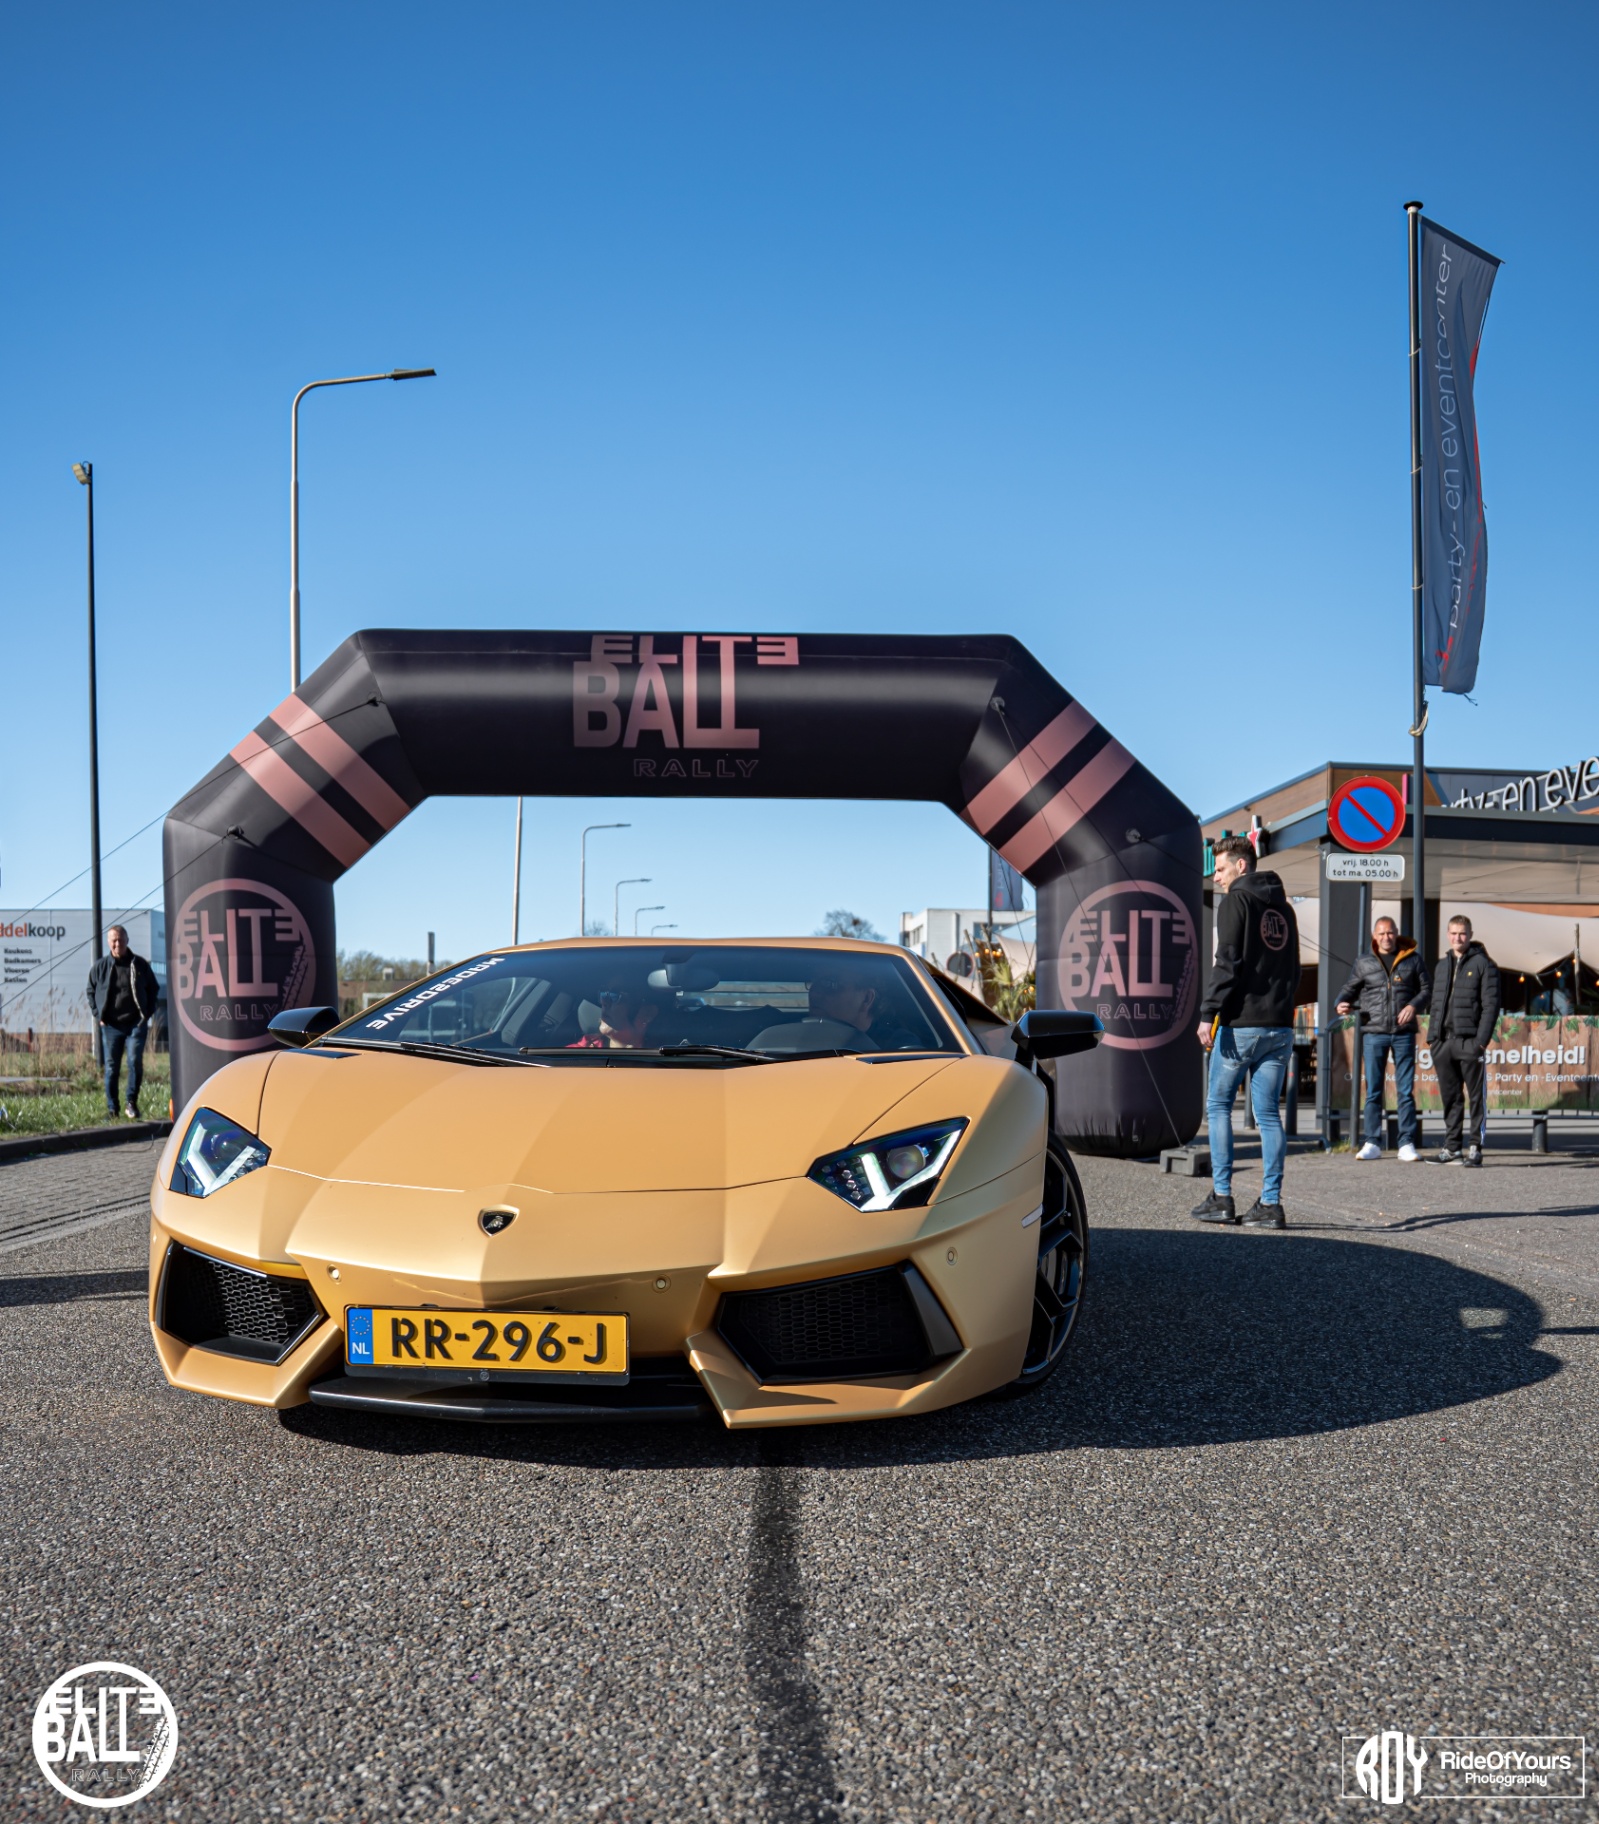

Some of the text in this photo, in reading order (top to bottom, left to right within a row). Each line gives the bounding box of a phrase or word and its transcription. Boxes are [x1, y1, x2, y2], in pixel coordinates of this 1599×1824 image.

[1444, 468, 1461, 510] en
[573, 660, 760, 749] BALL
[633, 759, 759, 777] RALLY
[1360, 859, 1382, 867] 18.00
[1384, 859, 1389, 867] h
[1365, 869, 1391, 878] 05.00
[1393, 870, 1399, 878] h
[201, 1003, 278, 1021] RALLY
[1097, 1003, 1174, 1020] RALLY
[1484, 1045, 1585, 1065] snelheid!
[1495, 1072, 1522, 1083] Party
[1525, 1074, 1538, 1082] en
[352, 1341, 370, 1355] NL
[390, 1317, 608, 1365] RR-296-J
